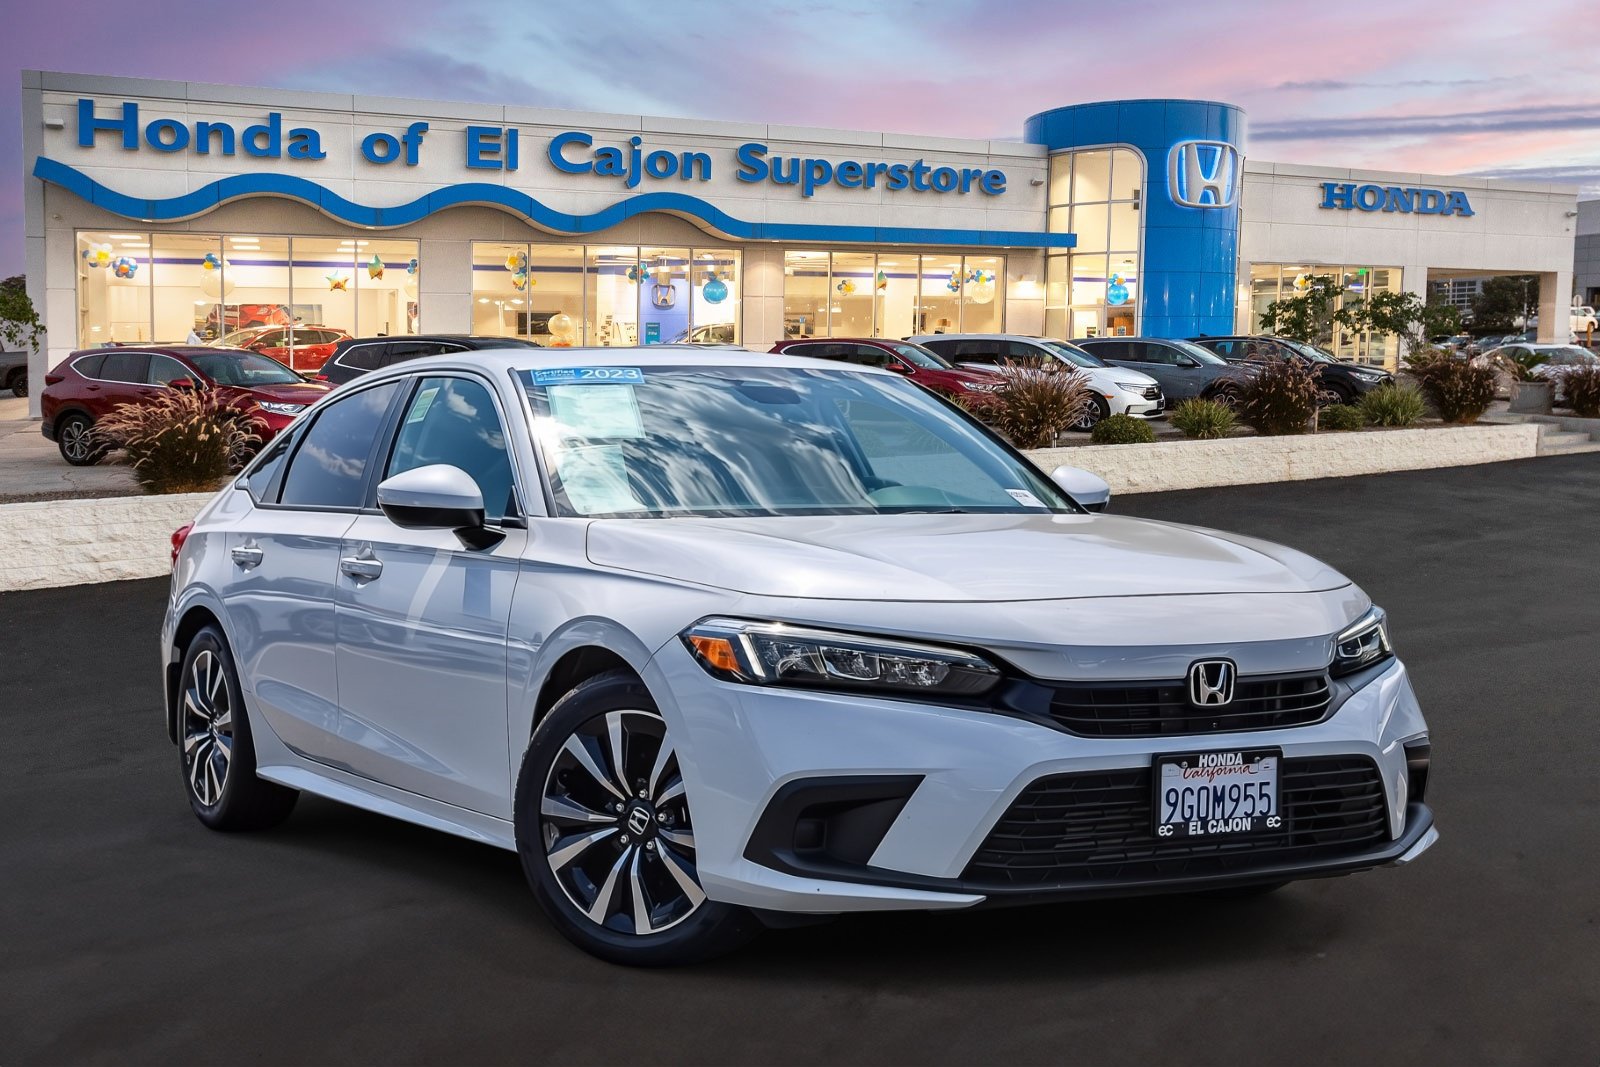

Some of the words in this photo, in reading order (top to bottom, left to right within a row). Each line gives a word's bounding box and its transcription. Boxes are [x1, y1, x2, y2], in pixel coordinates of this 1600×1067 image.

[77, 98, 327, 160] Honda
[360, 121, 429, 165] of
[465, 125, 519, 170] El
[547, 131, 713, 189] Cajon
[736, 143, 1008, 197] Superstore
[1319, 182, 1475, 216] HONDA
[580, 369, 639, 379] 2023
[1198, 752, 1244, 768] HONDA
[1183, 764, 1258, 783] California
[1188, 821, 1205, 836] EL
[1208, 817, 1252, 834] CAJON
